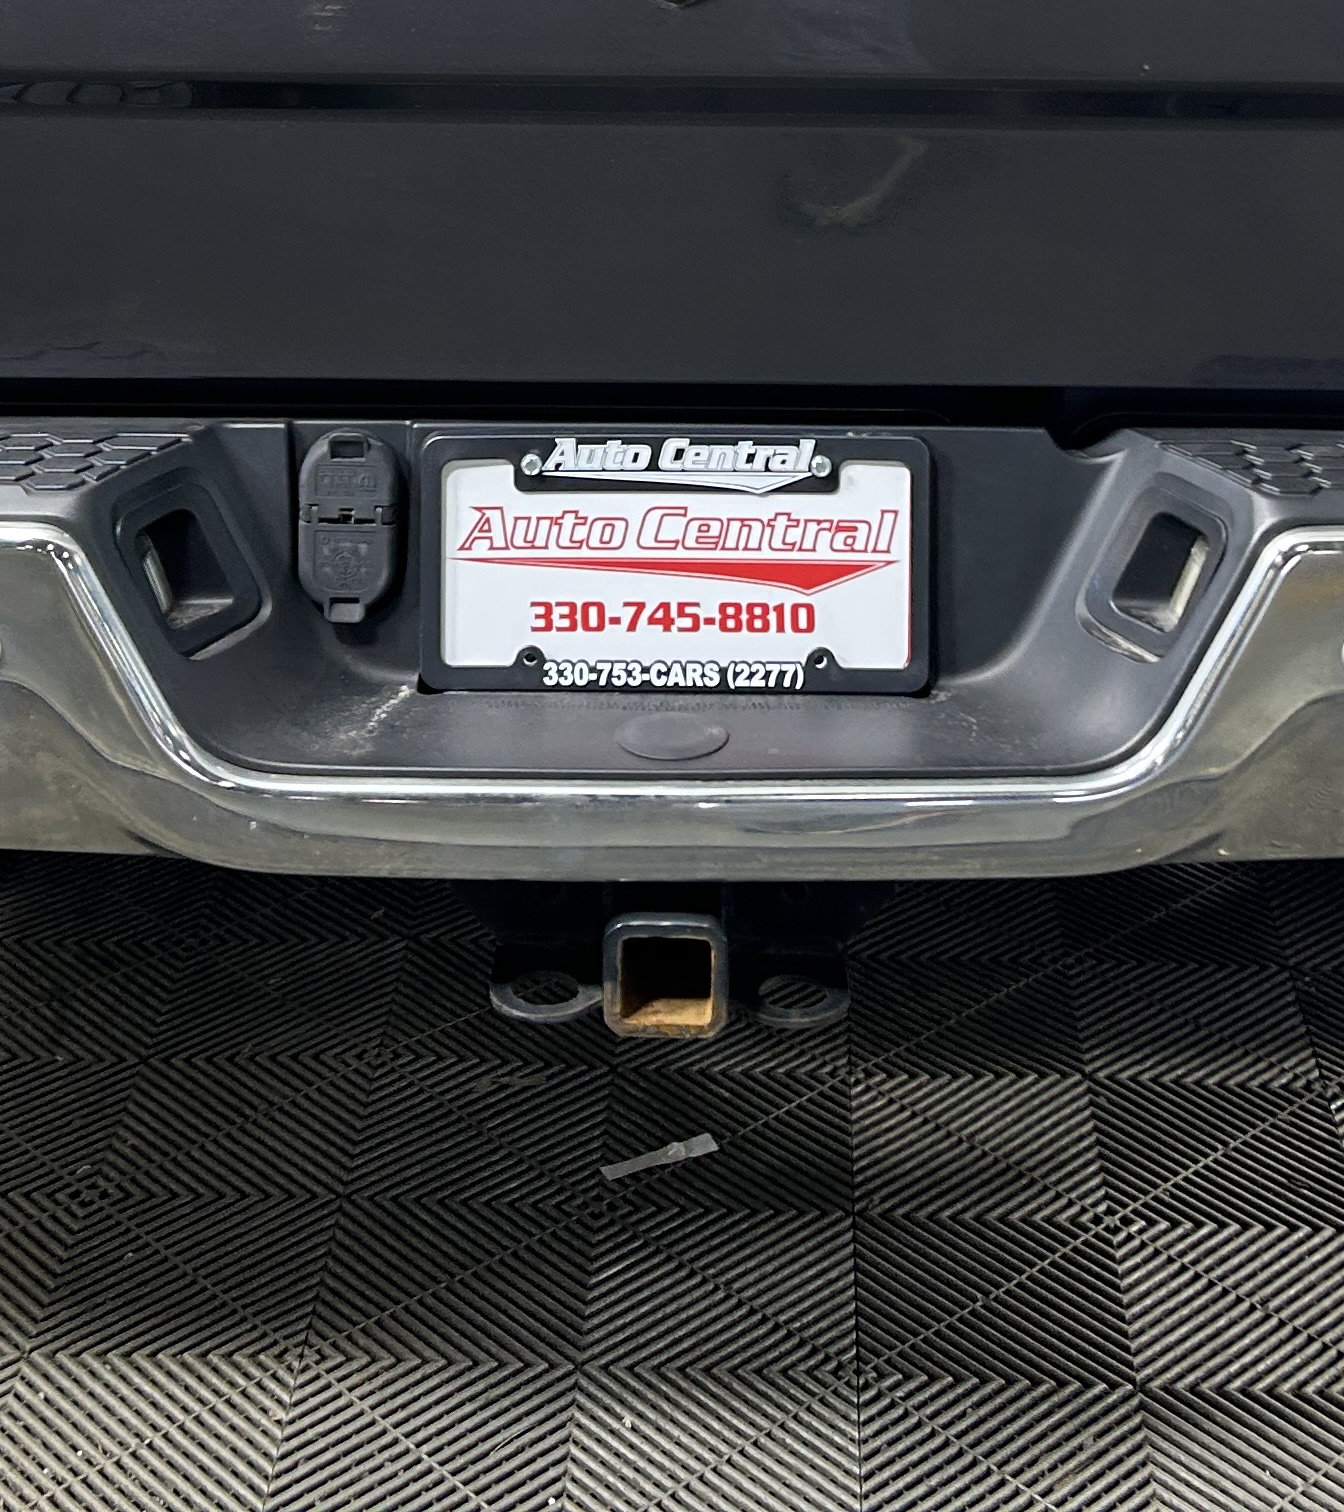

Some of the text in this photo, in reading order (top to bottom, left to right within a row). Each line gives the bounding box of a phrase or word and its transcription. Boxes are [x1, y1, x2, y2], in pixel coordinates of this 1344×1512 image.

[541, 438, 817, 472] Auto Central
[457, 506, 899, 554] Auto Central
[530, 601, 816, 634] 330-745-8810
[542, 660, 805, 690] 330-753-CARS (2277)
